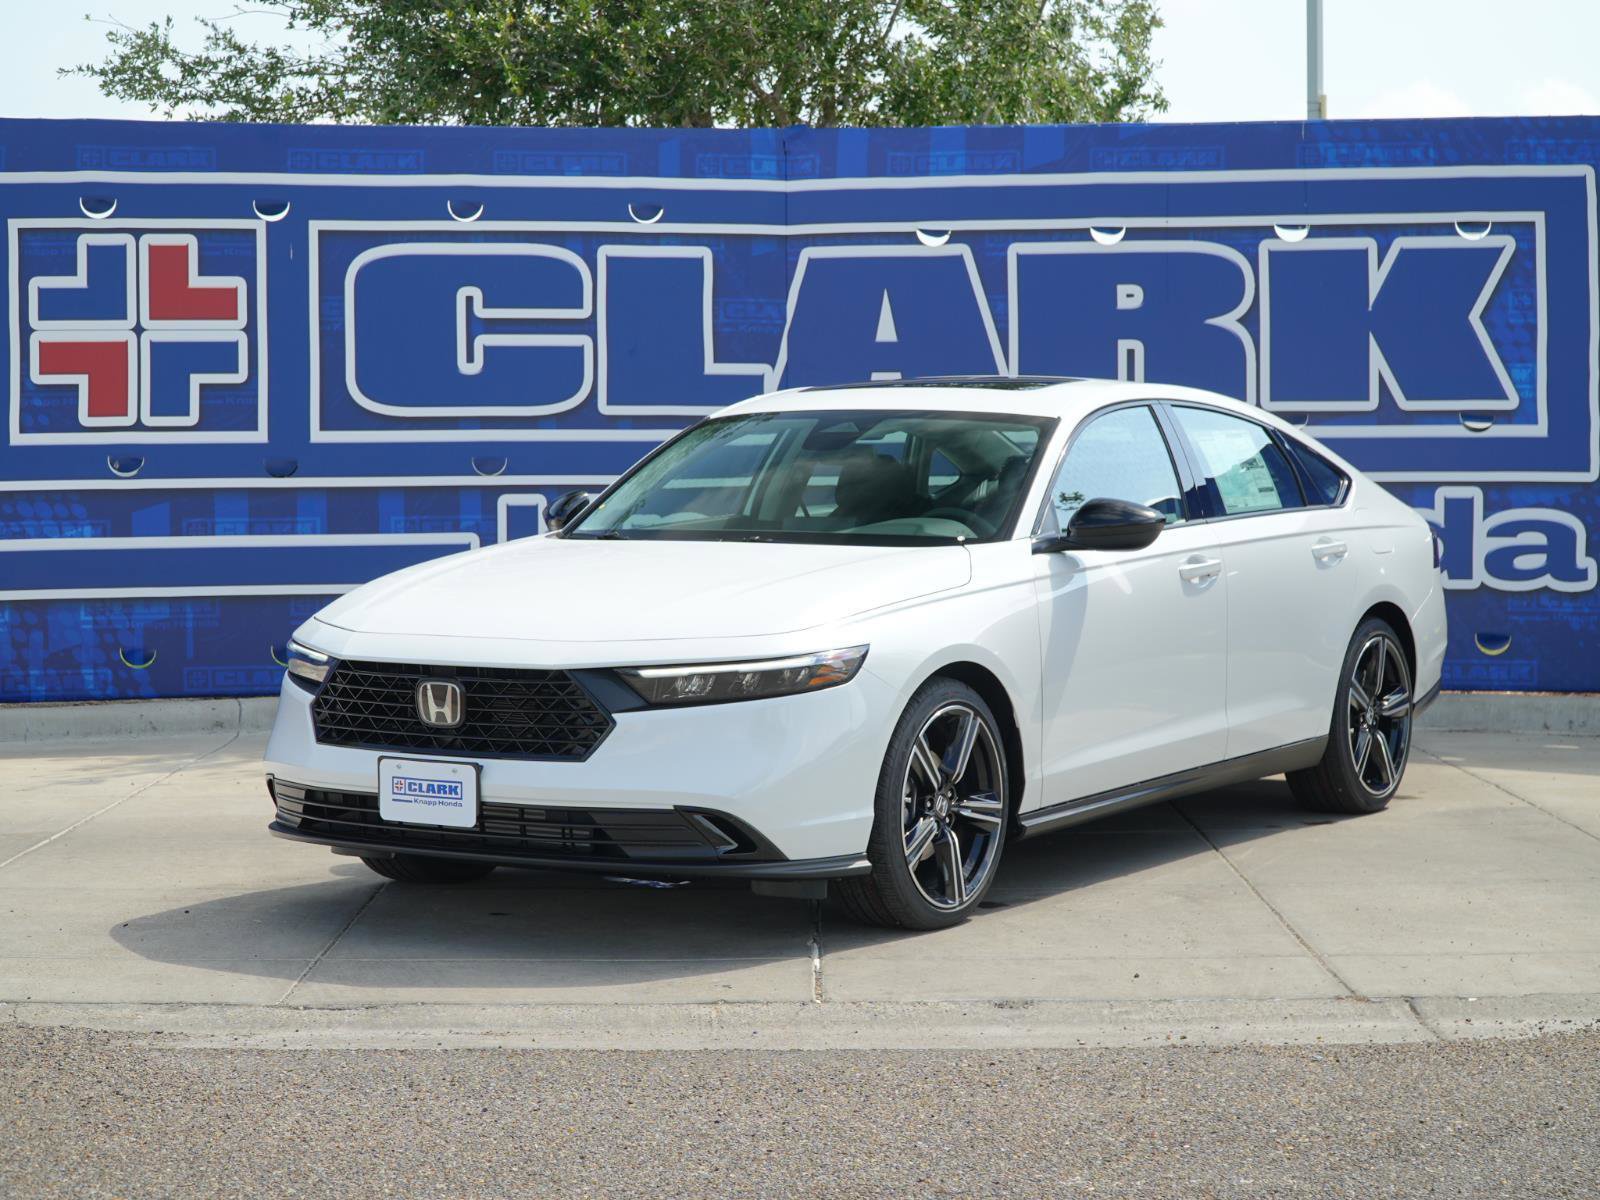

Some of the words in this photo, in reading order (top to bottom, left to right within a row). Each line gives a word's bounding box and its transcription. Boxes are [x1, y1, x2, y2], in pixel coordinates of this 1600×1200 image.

[345, 235, 1520, 418] CLARK
[407, 781, 460, 796] CLARK
[413, 798, 437, 806] Knapp
